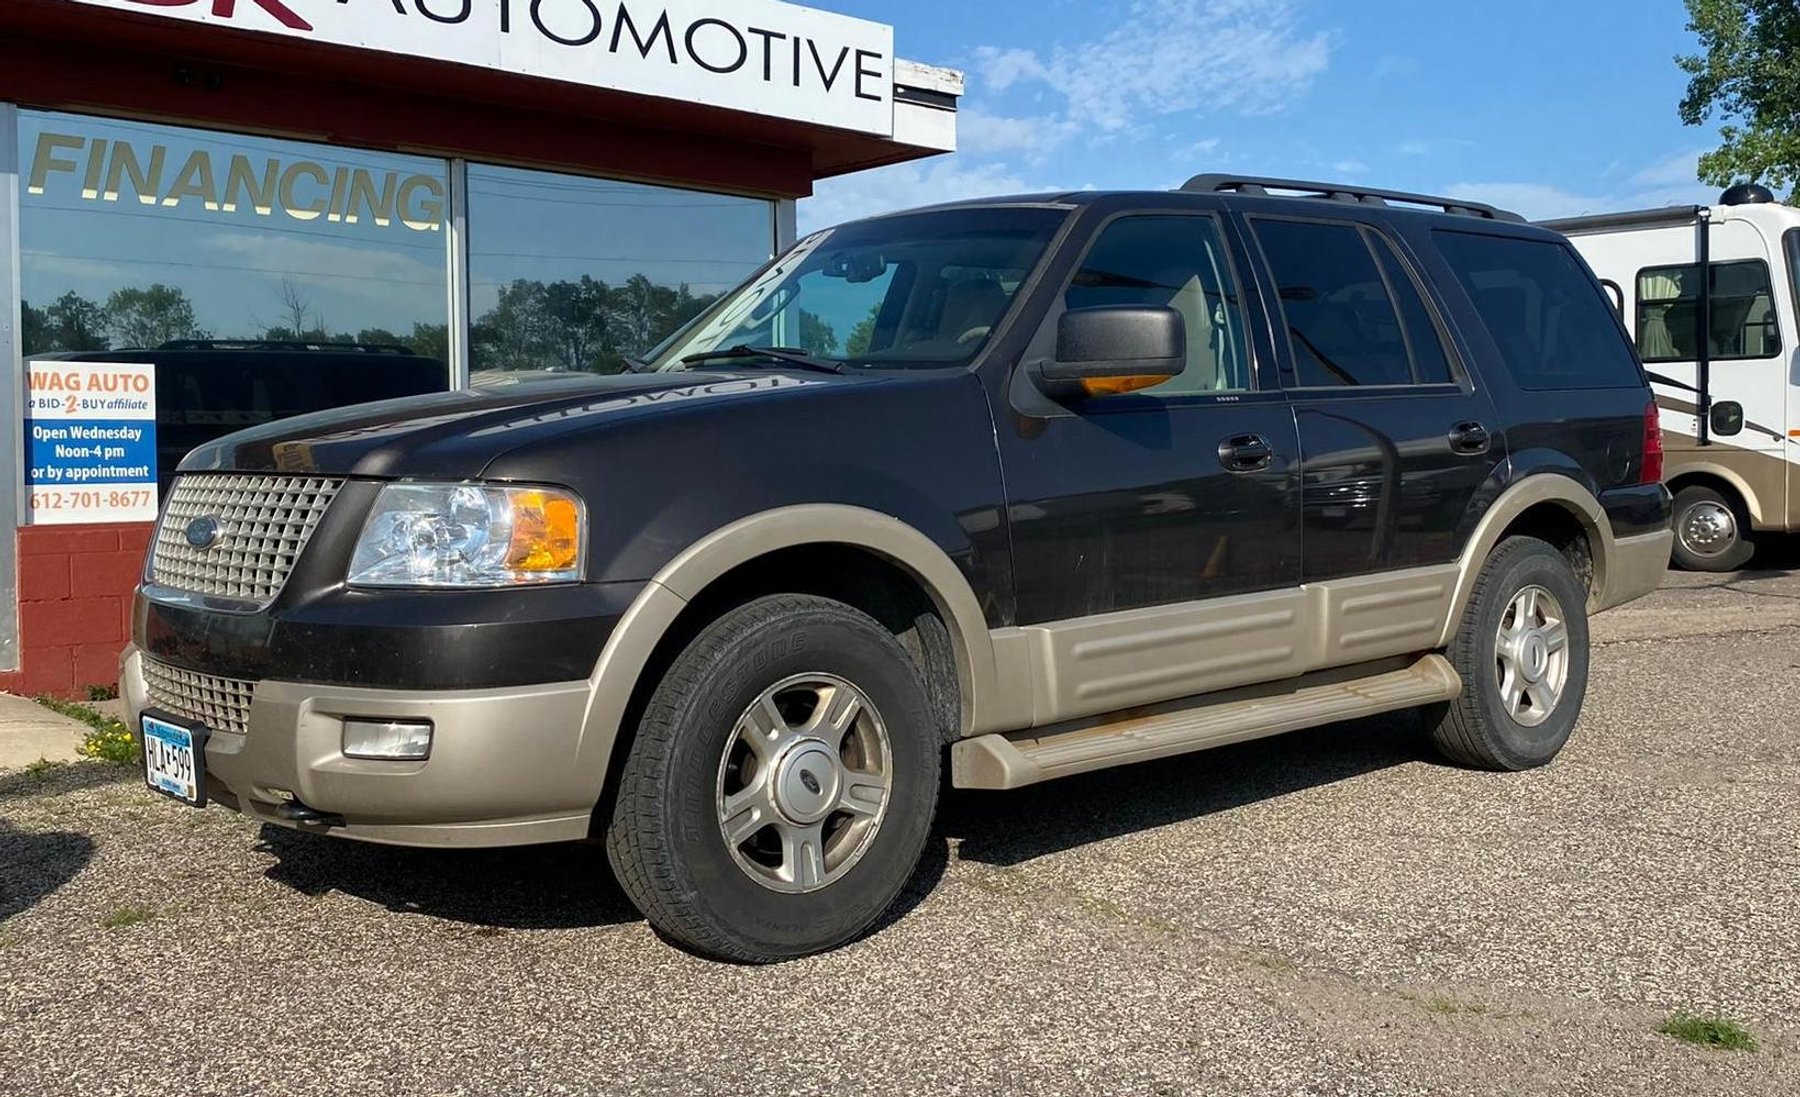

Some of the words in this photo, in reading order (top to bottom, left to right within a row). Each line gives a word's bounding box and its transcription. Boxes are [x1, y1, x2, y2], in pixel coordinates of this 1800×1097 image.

[336, 0, 882, 101] OMOTIVE
[27, 132, 444, 231] FINANCING
[26, 372, 81, 391] WAG
[87, 374, 150, 392] AUTO
[28, 400, 35, 408] a
[107, 399, 148, 410] affiliate
[33, 426, 67, 442] Open
[70, 426, 142, 442] Wednesday
[56, 444, 102, 458] Noon-4
[104, 447, 125, 460] pm
[31, 467, 45, 478] or
[47, 464, 64, 481] by
[66, 465, 149, 480] appointment
[30, 491, 151, 510] 612-701-8677
